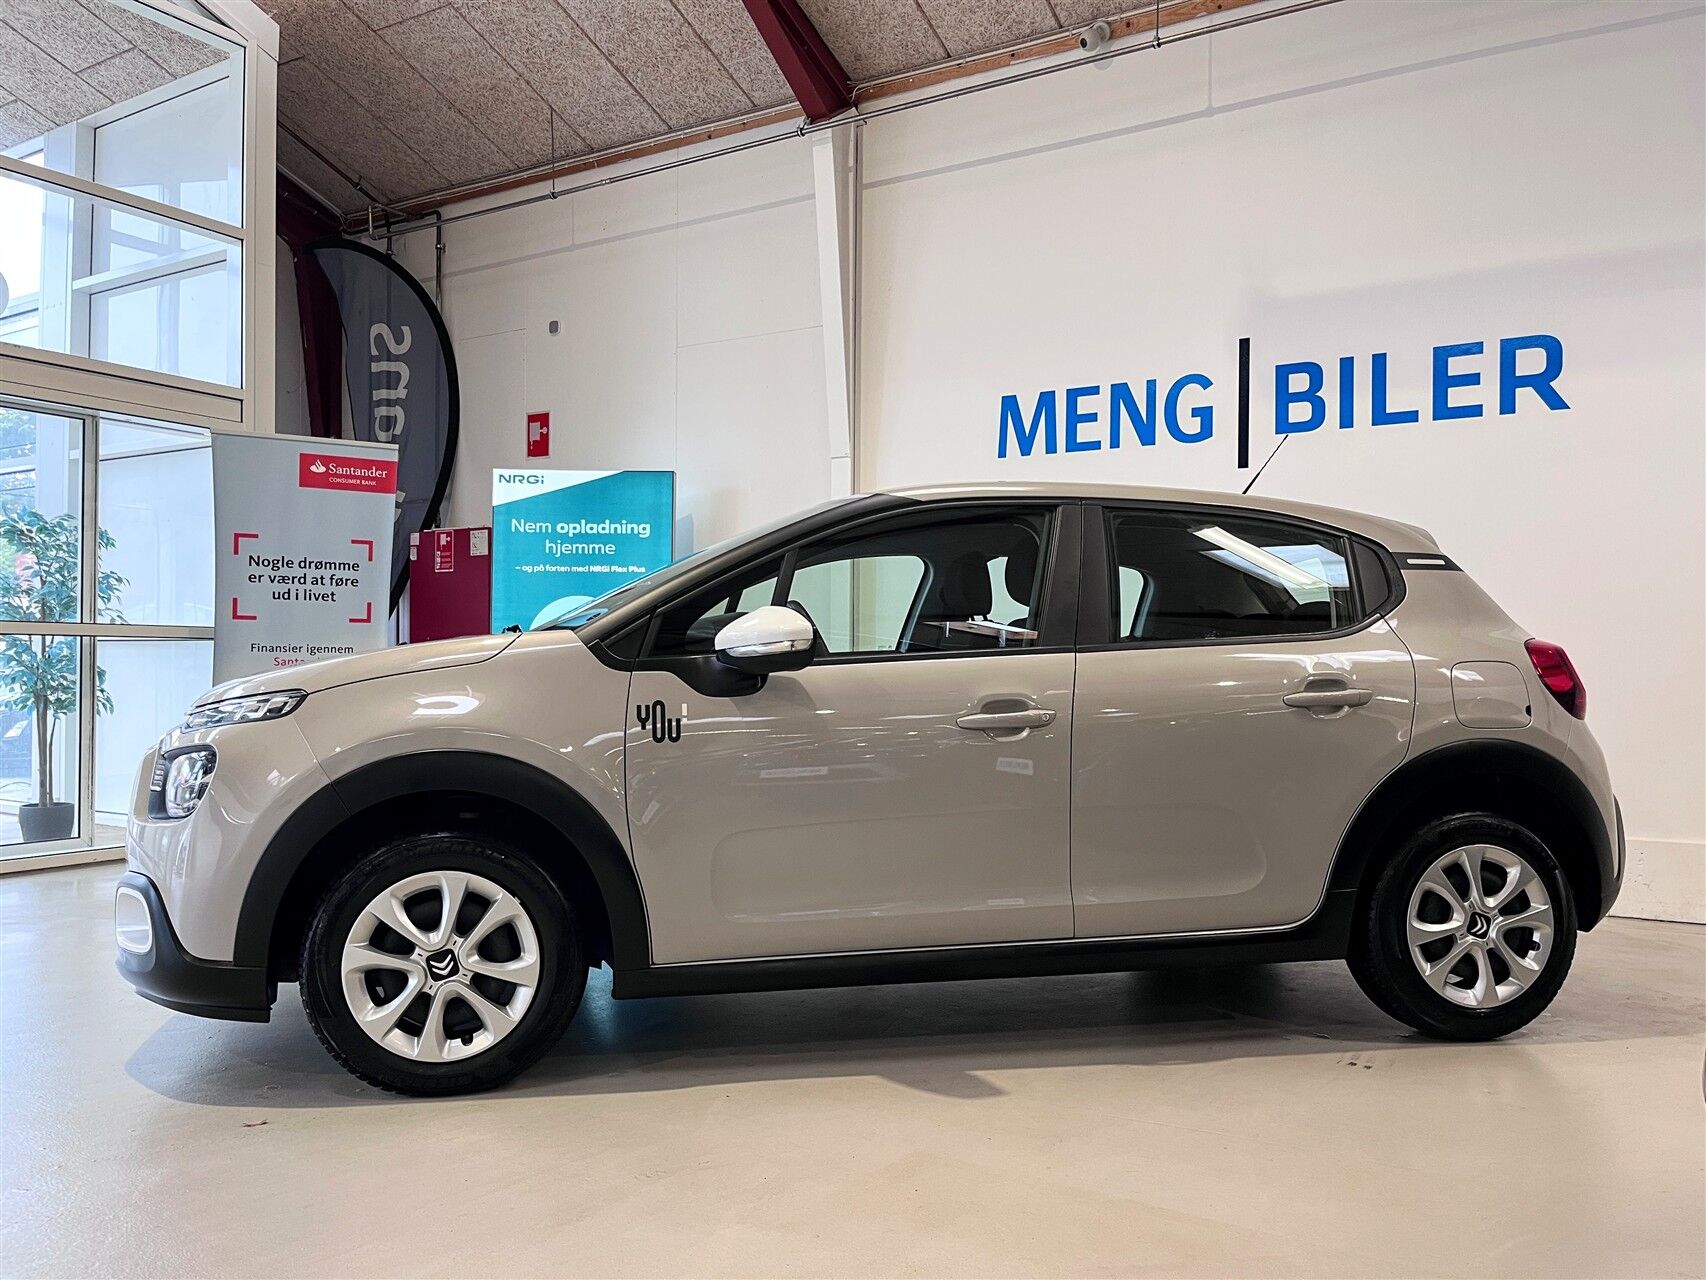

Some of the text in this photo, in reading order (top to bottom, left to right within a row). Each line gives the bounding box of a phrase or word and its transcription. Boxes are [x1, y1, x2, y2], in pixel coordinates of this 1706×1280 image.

[998, 334, 1571, 459] MENG BILER
[328, 463, 388, 478] Santander
[328, 476, 360, 485] CONSUMER
[498, 474, 545, 485] NRGi
[511, 518, 651, 538] Nem opladning
[545, 539, 616, 557] hjemme
[248, 555, 360, 572] Nogle drømme
[521, 565, 532, 573] og
[534, 564, 544, 573] på
[571, 565, 588, 573] med
[611, 565, 627, 573] Flex
[248, 573, 360, 587] er værd at føre
[272, 588, 337, 602] ud i livet
[250, 643, 354, 656] Finansier igennem
